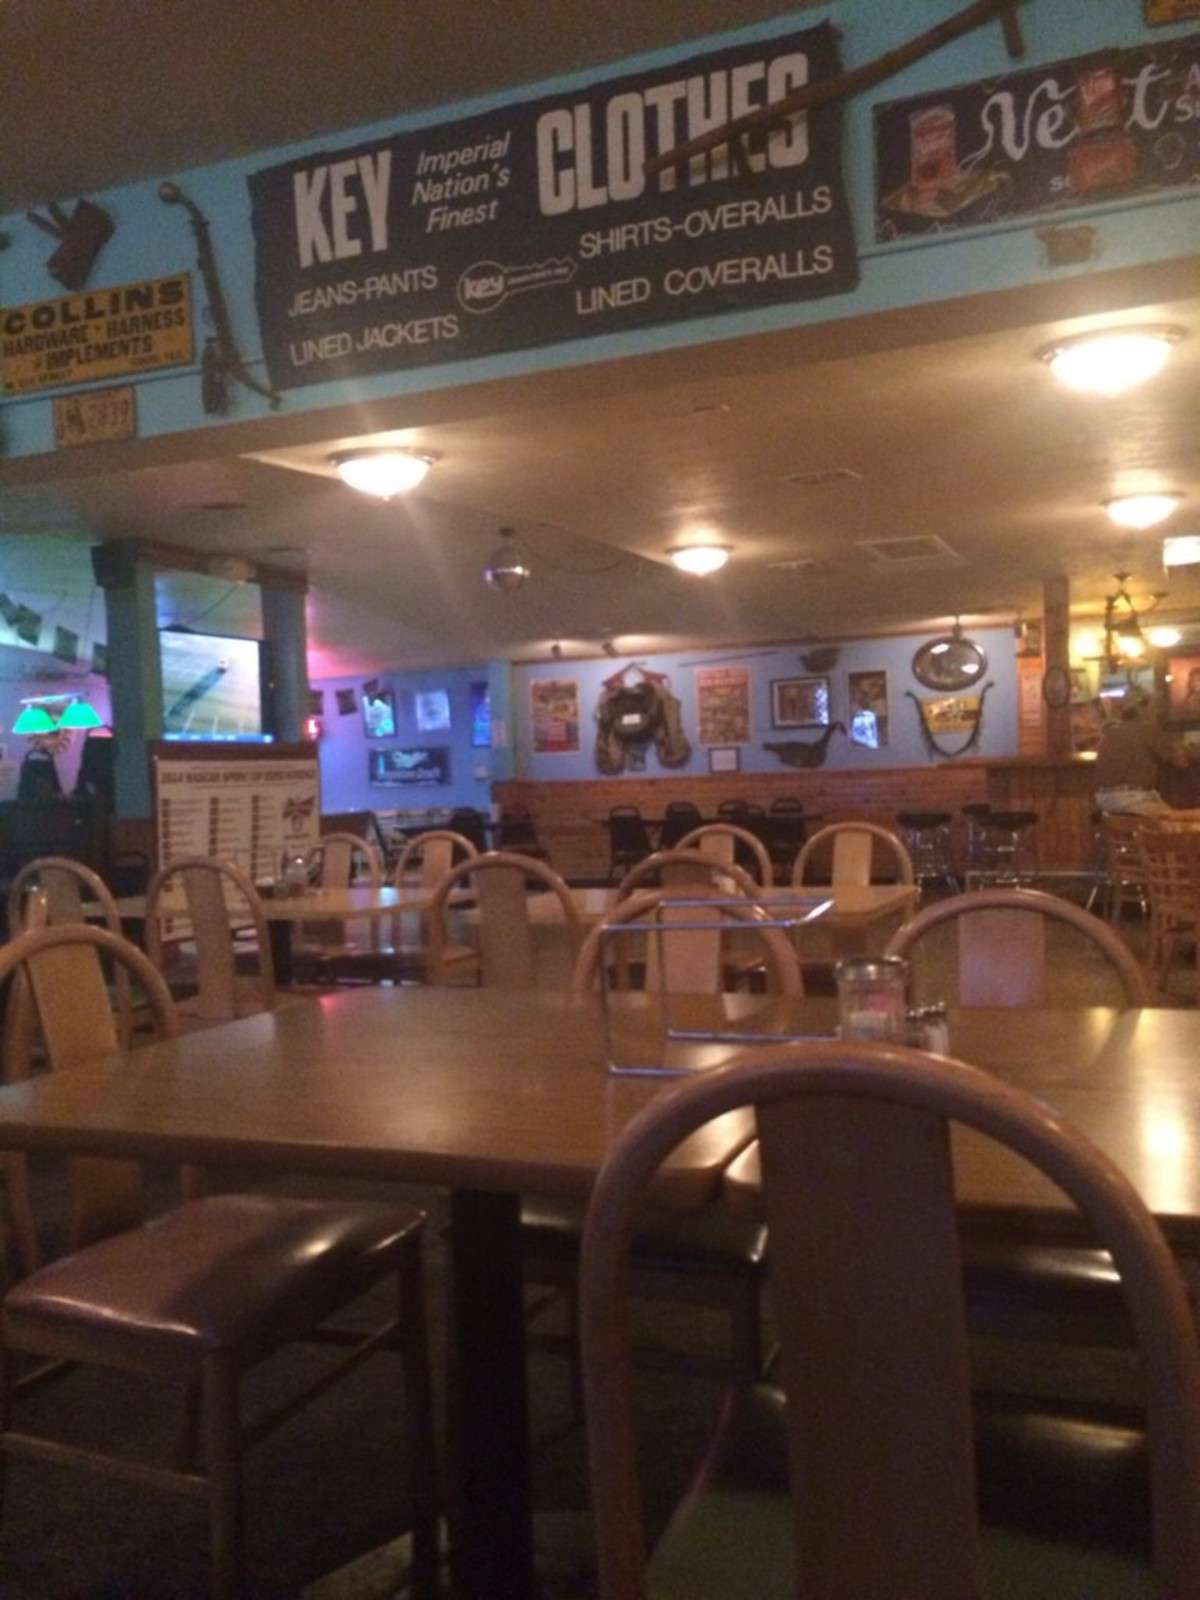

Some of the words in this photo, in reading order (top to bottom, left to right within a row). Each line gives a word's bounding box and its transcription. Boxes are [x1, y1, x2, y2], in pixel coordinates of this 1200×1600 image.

[416, 130, 511, 177] Imperial
[537, 52, 809, 217] CLOTHES
[293, 149, 392, 269] KEY
[411, 163, 511, 206] Nation's
[425, 200, 499, 234] Finest
[579, 185, 833, 259] SHIRTS-OVERALLS
[288, 265, 439, 317] JEANS-PANTS
[576, 279, 652, 315] LINED
[664, 244, 834, 296] COVERALLS
[5, 280, 184, 334] COLLINS
[106, 307, 185, 340] HARNESS
[290, 331, 352, 366] LINED
[356, 314, 460, 352] JACKETS
